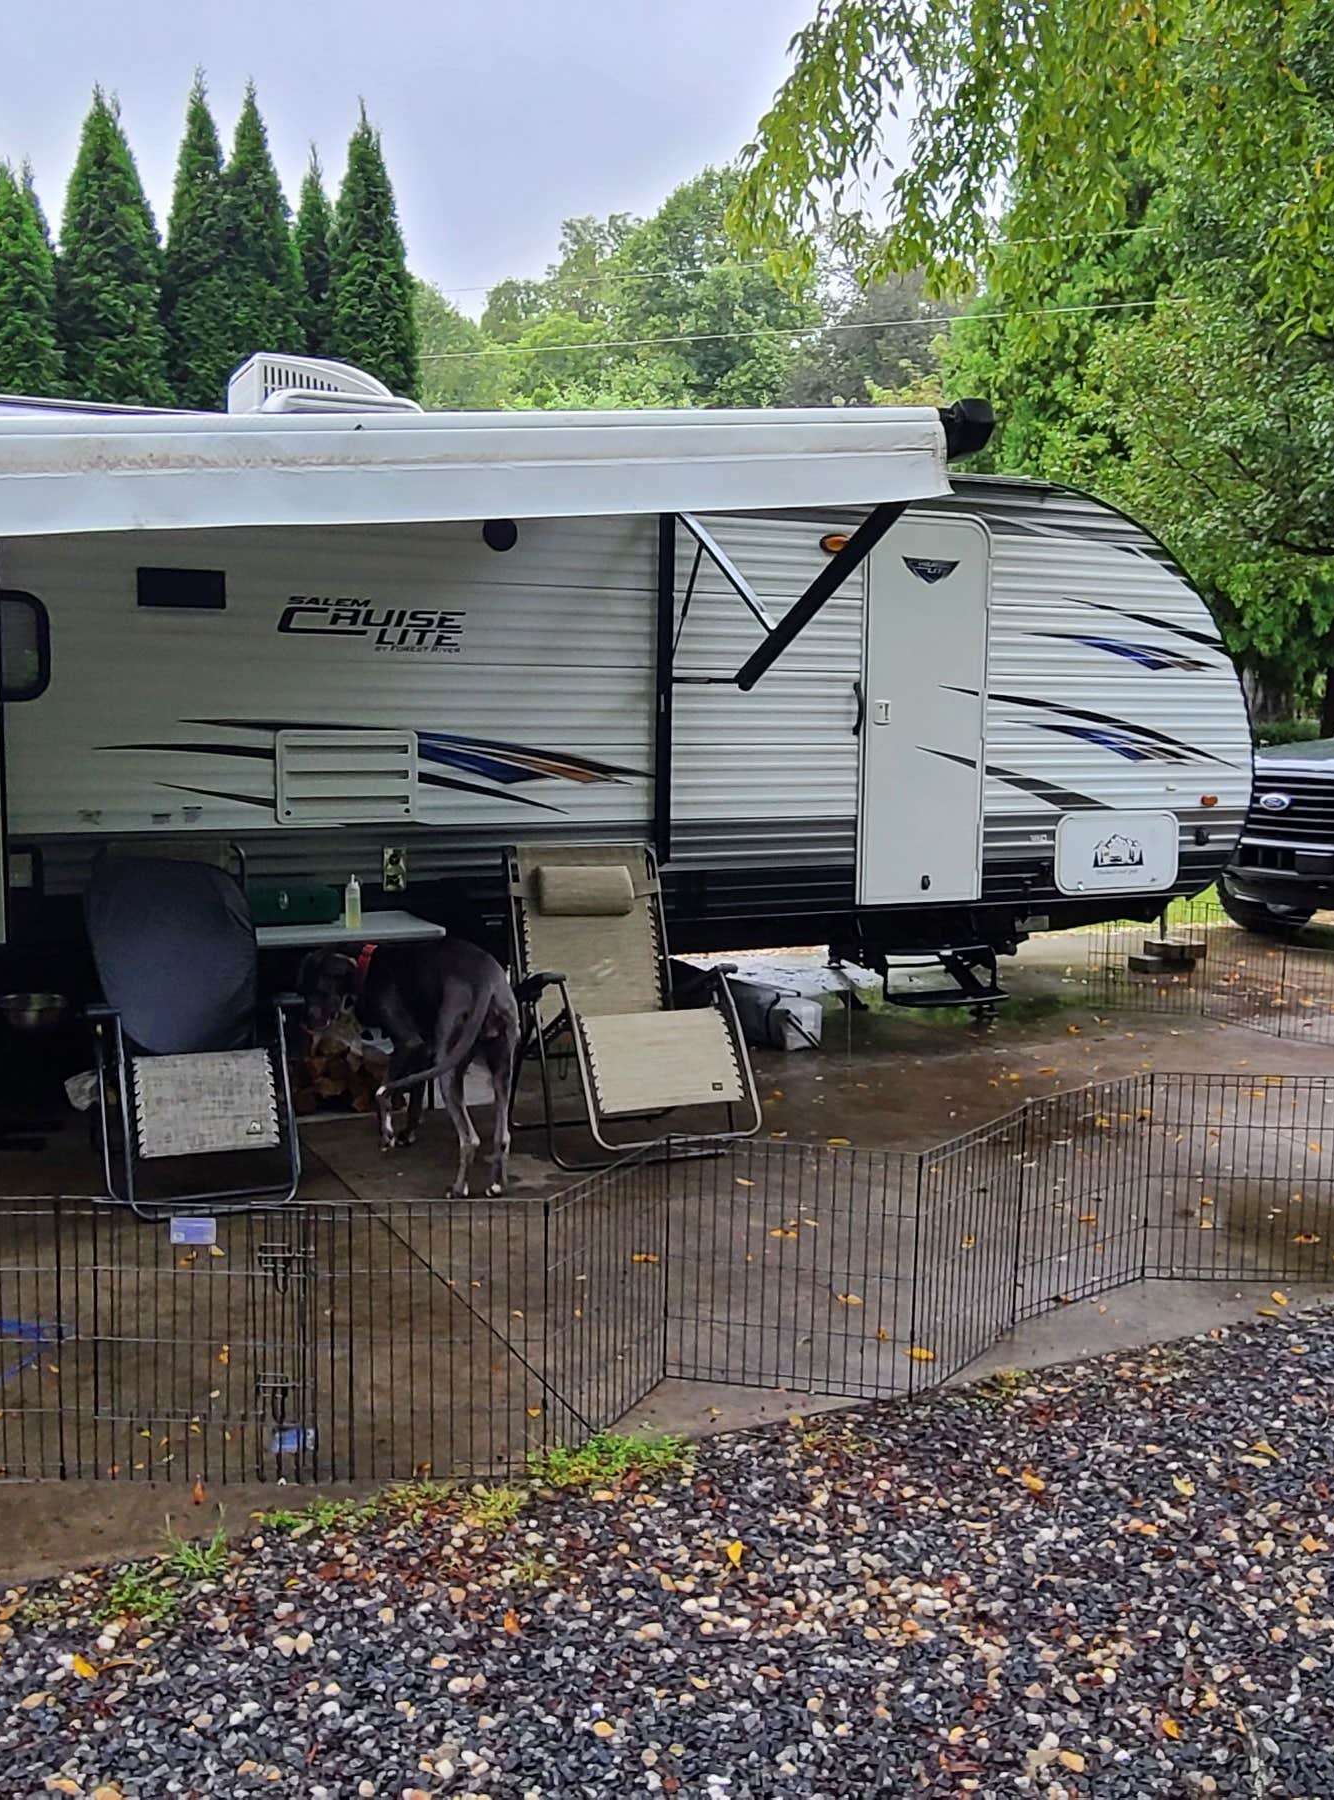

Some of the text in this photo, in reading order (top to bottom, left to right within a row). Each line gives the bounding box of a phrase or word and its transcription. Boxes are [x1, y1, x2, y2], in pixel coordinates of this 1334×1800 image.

[287, 596, 371, 607] SALEM
[277, 606, 466, 636] CRUISE
[375, 628, 463, 646] LITE
